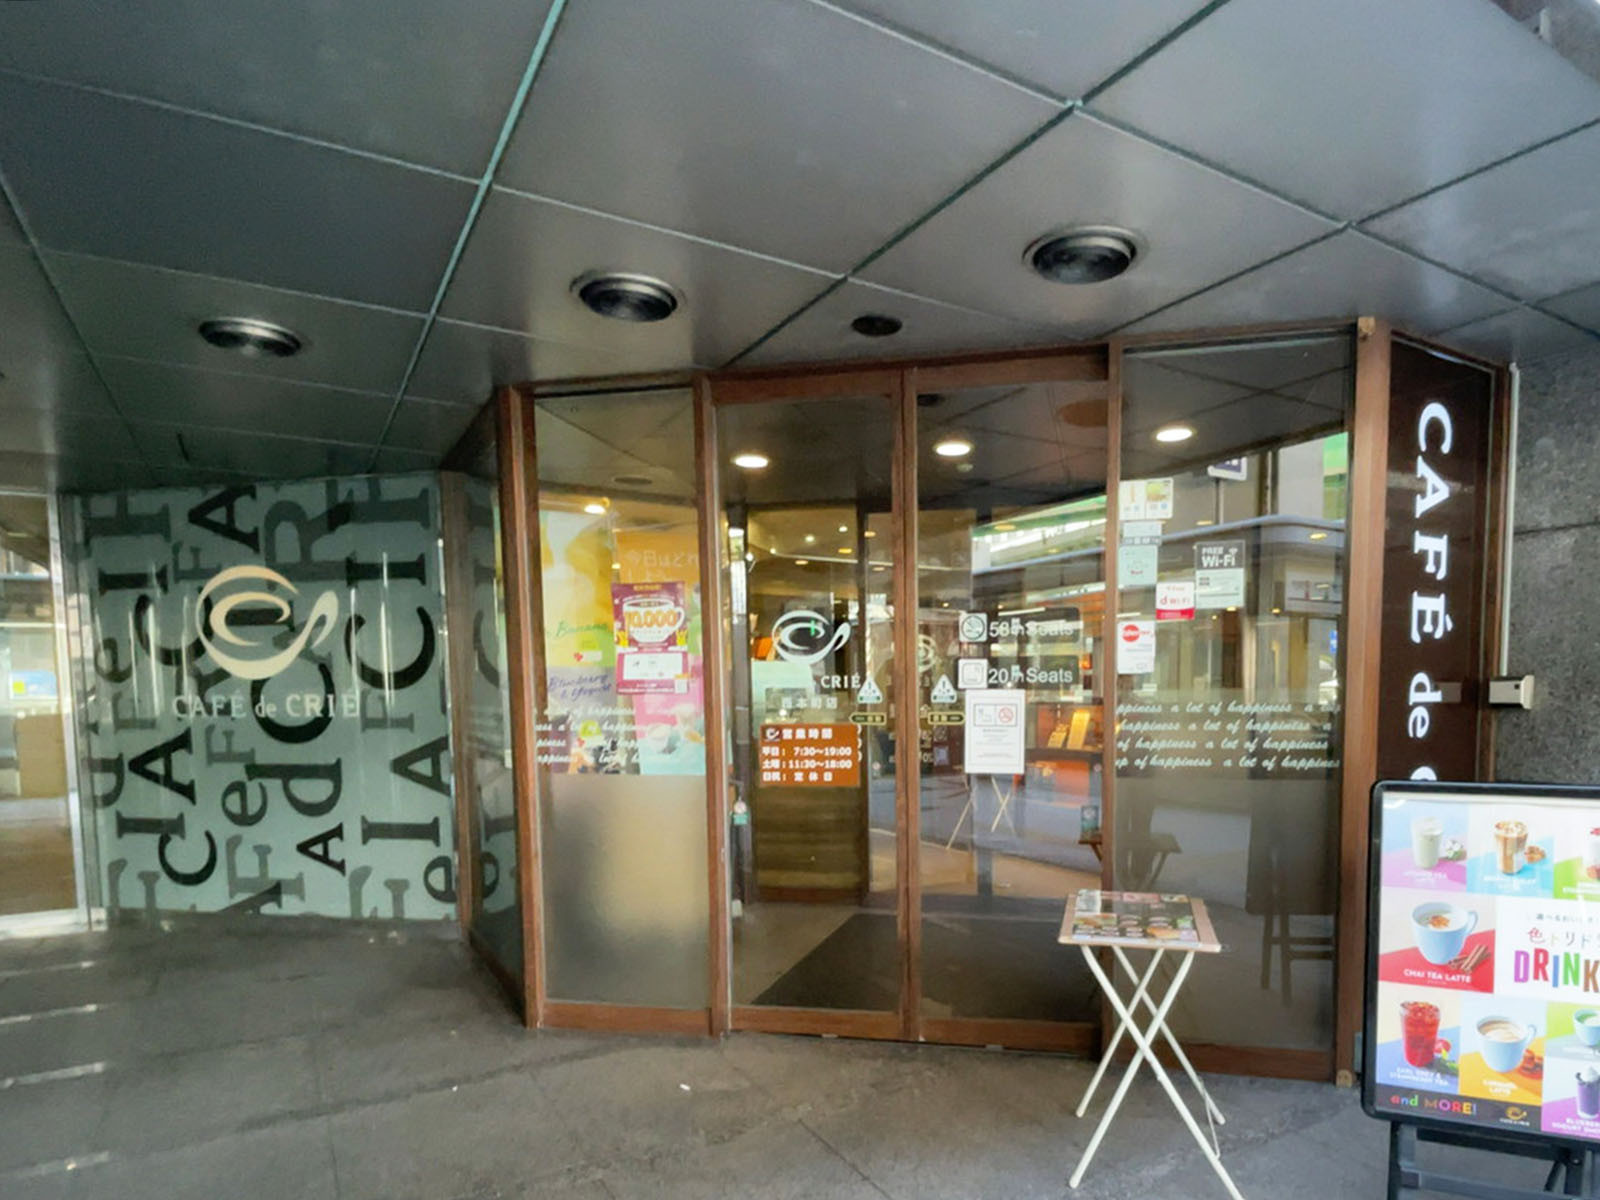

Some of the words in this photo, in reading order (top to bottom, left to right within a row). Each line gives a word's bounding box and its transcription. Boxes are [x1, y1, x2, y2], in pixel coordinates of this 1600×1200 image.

[1411, 401, 1453, 645] CAFÉ
[1201, 553, 1236, 568] Wi-Fi
[989, 621, 1010, 638] 58
[820, 672, 862, 689] CRIÉ
[988, 667, 1009, 684] 20
[1026, 667, 1074, 684] Seats
[171, 689, 247, 719] CAFÉ
[254, 694, 278, 719] de
[284, 689, 361, 719] CRIÉ
[1227, 700, 1293, 715] happiness
[1408, 672, 1442, 739] de
[1135, 736, 1197, 752] happiness
[1263, 737, 1328, 752] happiness
[1149, 755, 1213, 769] happiness
[1403, 968, 1425, 978] CHAI
[1427, 970, 1443, 980] TEA
[1445, 973, 1472, 983] LATTE
[1390, 1095, 1419, 1107] and
[1424, 1098, 1478, 1117] MORE!
